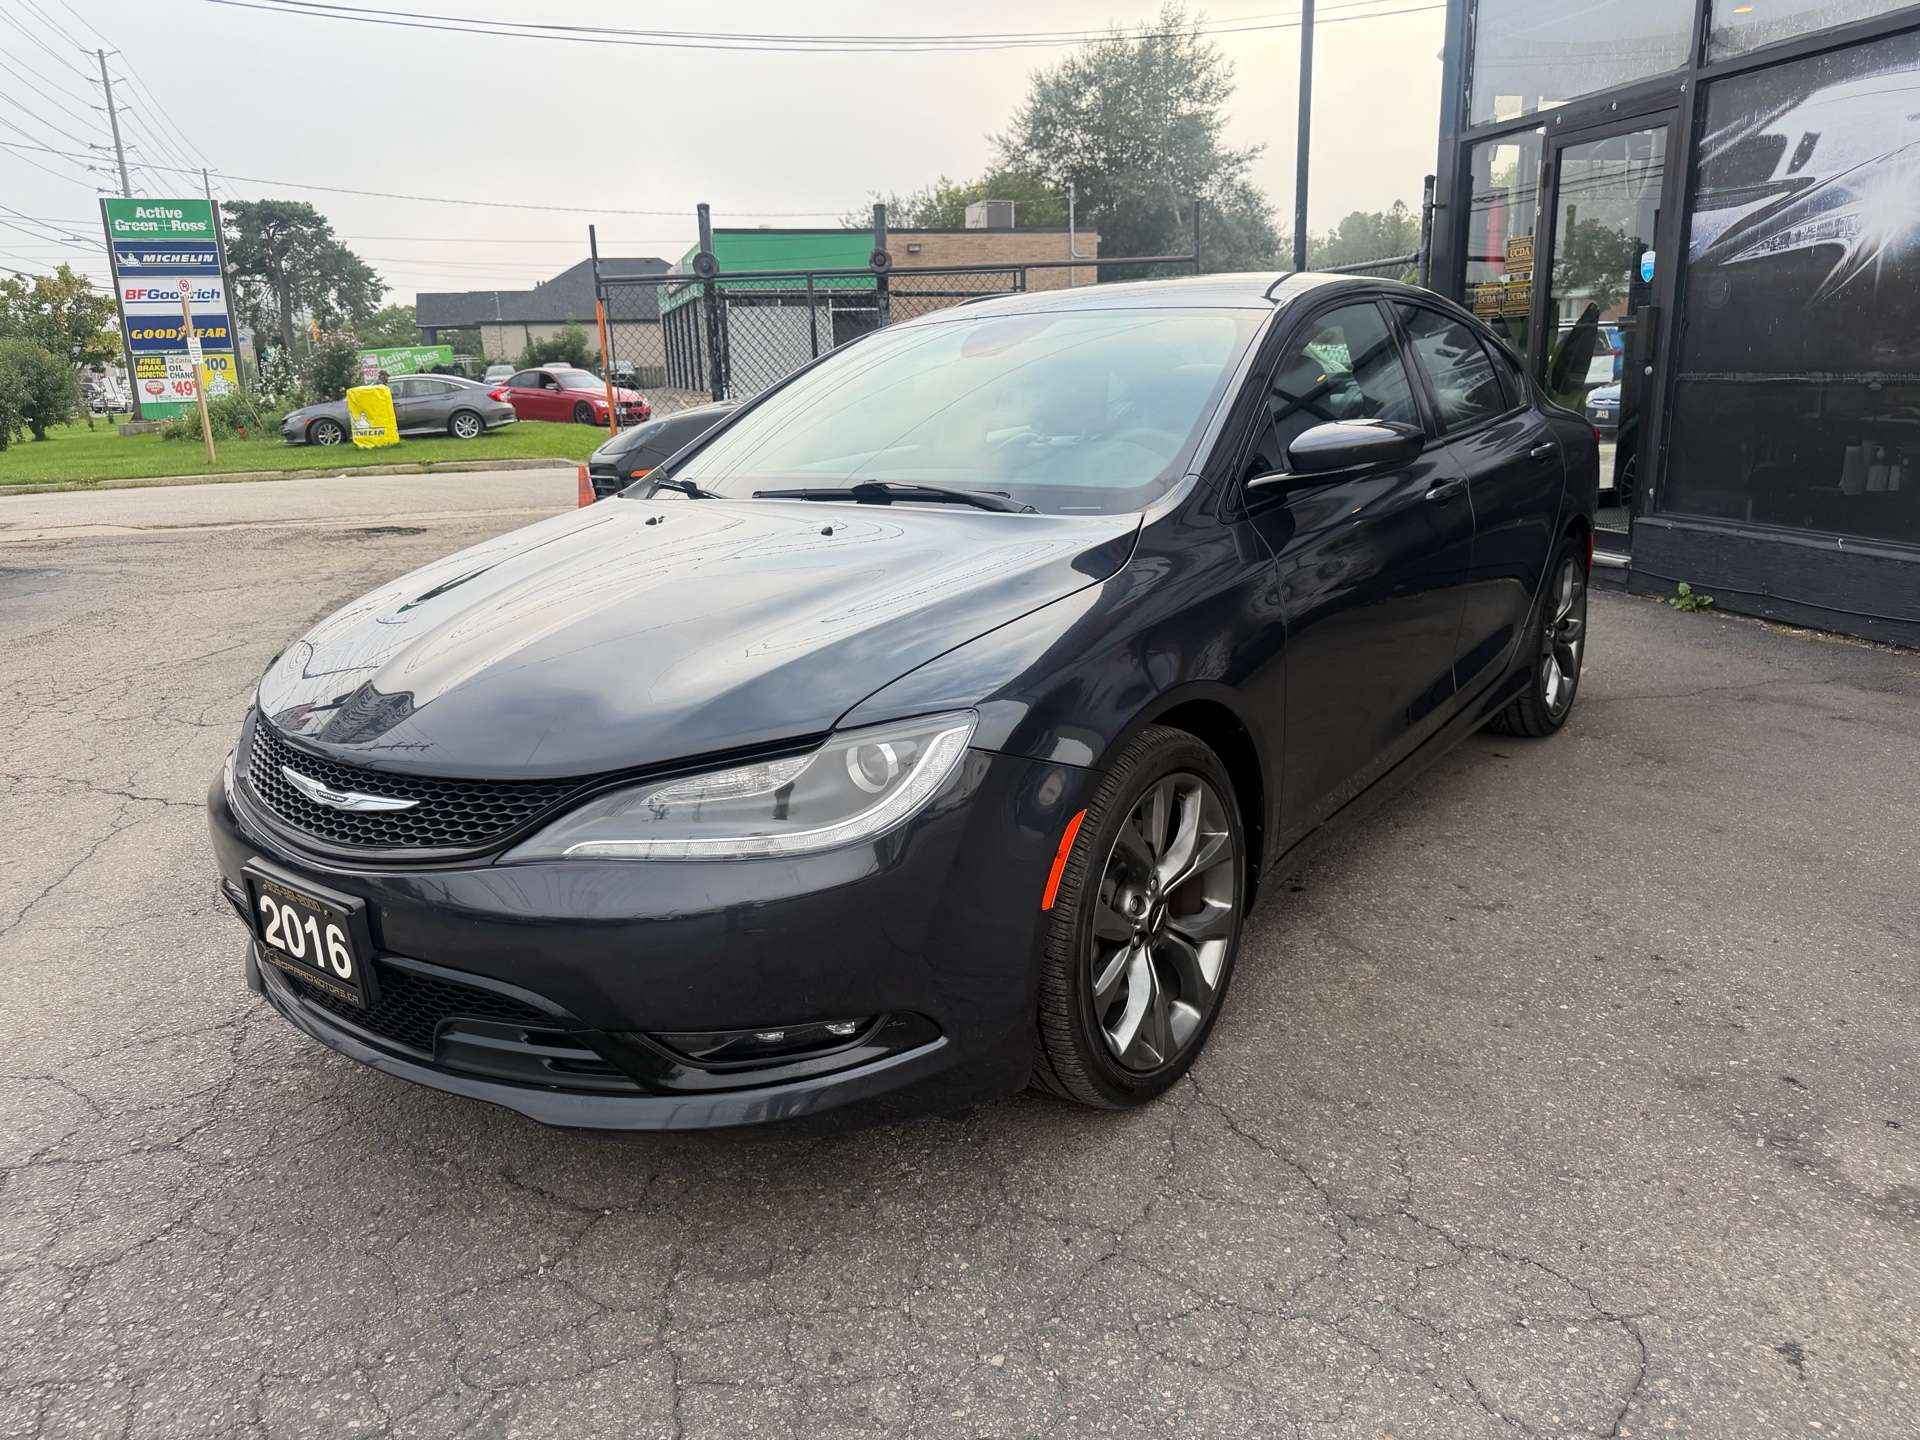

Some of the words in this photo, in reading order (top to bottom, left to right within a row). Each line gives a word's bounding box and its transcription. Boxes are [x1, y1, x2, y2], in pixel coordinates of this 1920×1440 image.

[136, 207, 183, 219] Active
[143, 254, 214, 263] MICHELIN
[125, 289, 221, 300] BFGoorich
[205, 358, 228, 370] 100
[260, 895, 352, 979] 2016
